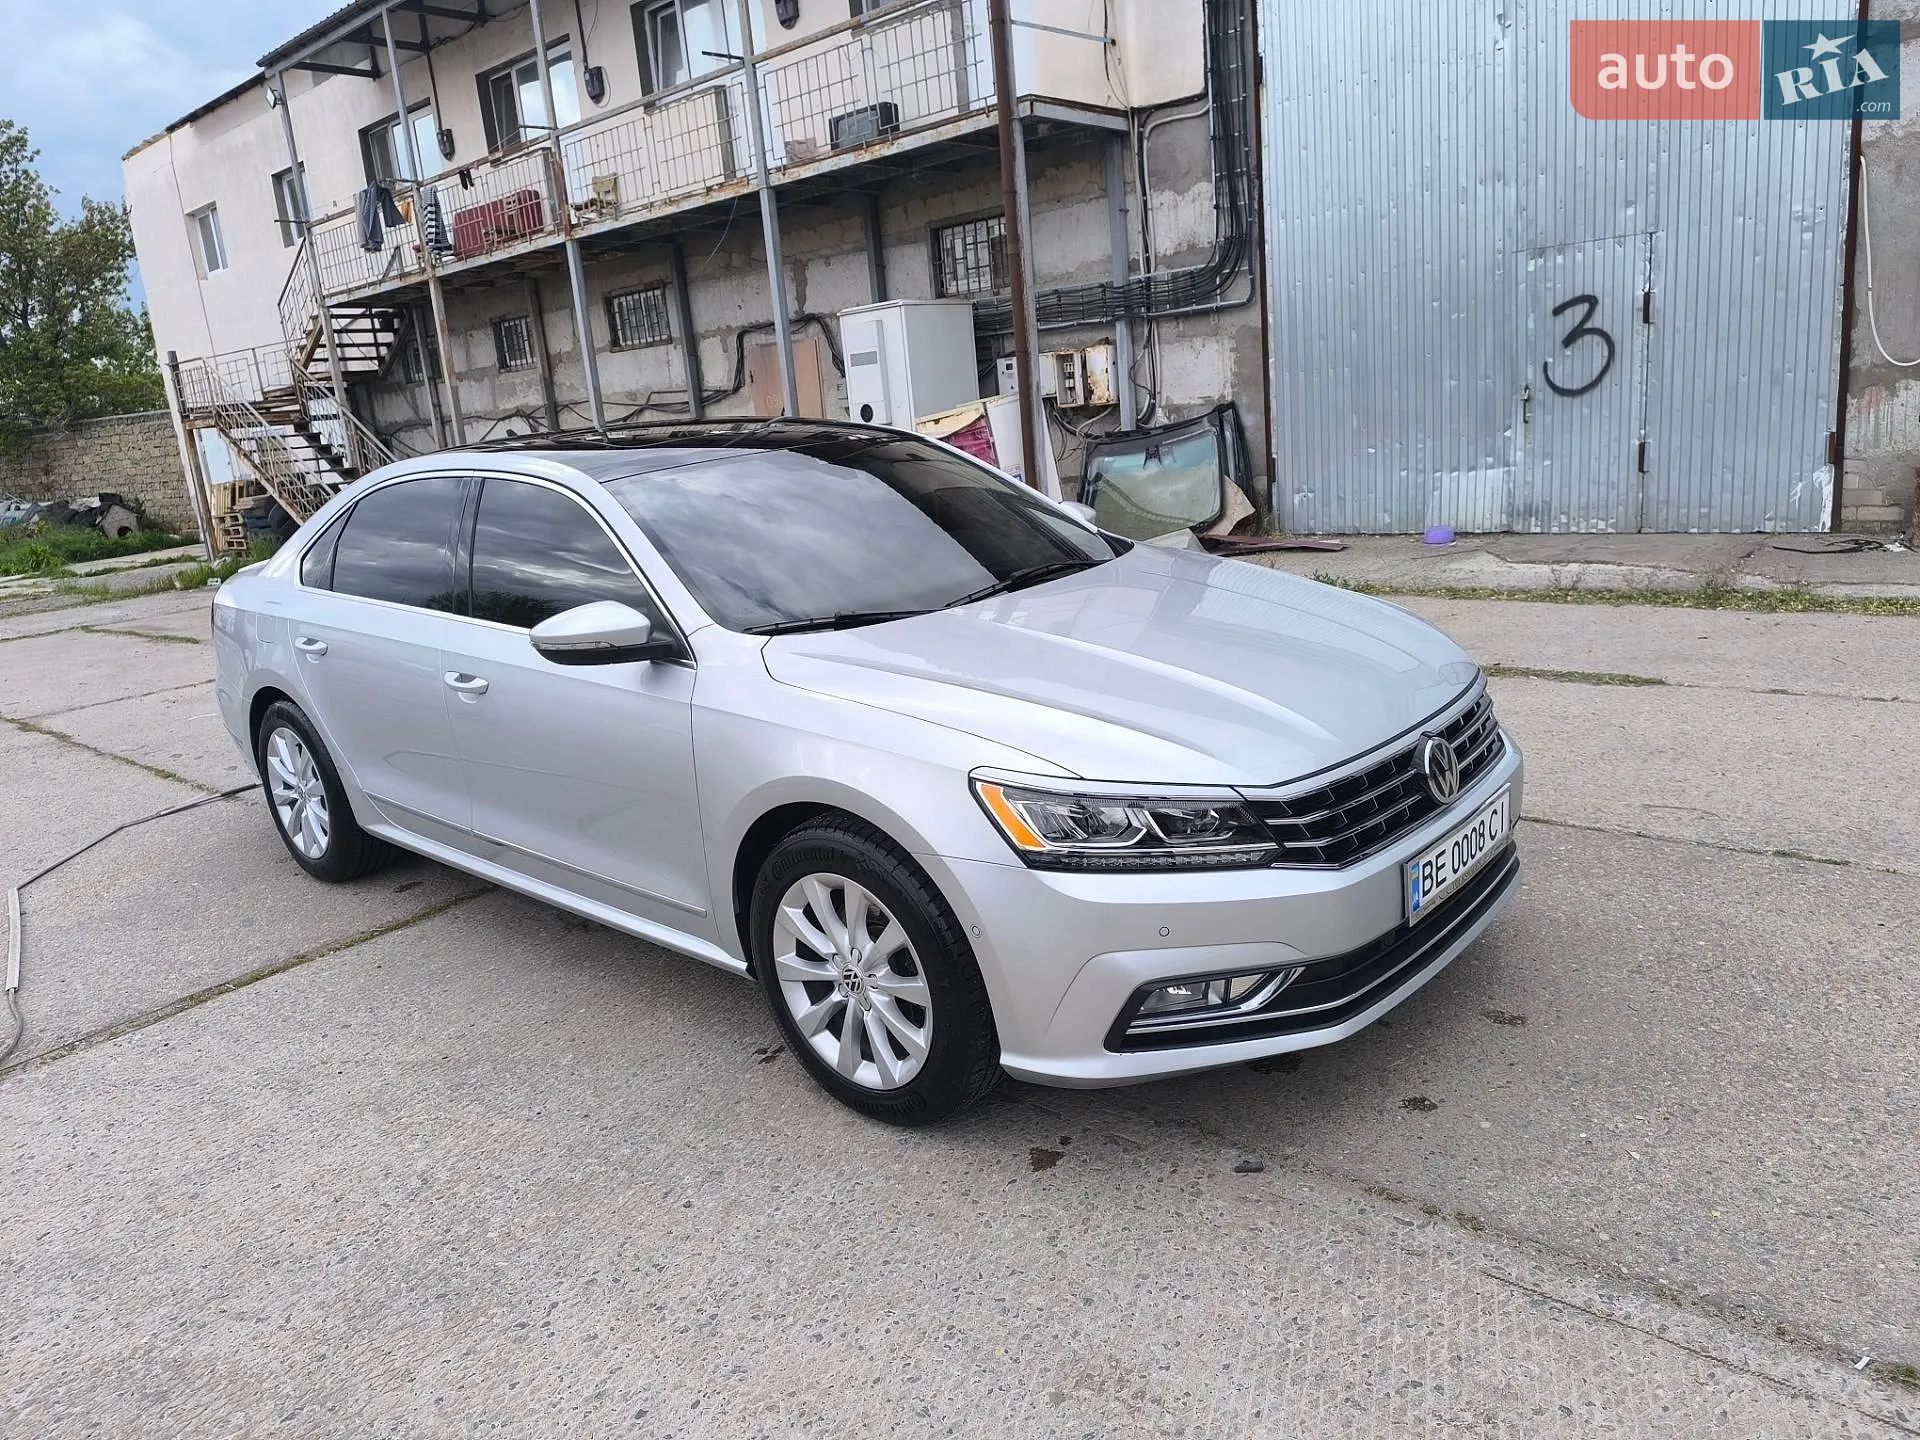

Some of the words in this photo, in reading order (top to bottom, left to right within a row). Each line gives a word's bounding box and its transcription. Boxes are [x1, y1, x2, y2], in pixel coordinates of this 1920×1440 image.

[1543, 294, 1615, 398] 3
[1422, 849, 1447, 898] BE
[1451, 819, 1486, 875] 0008
